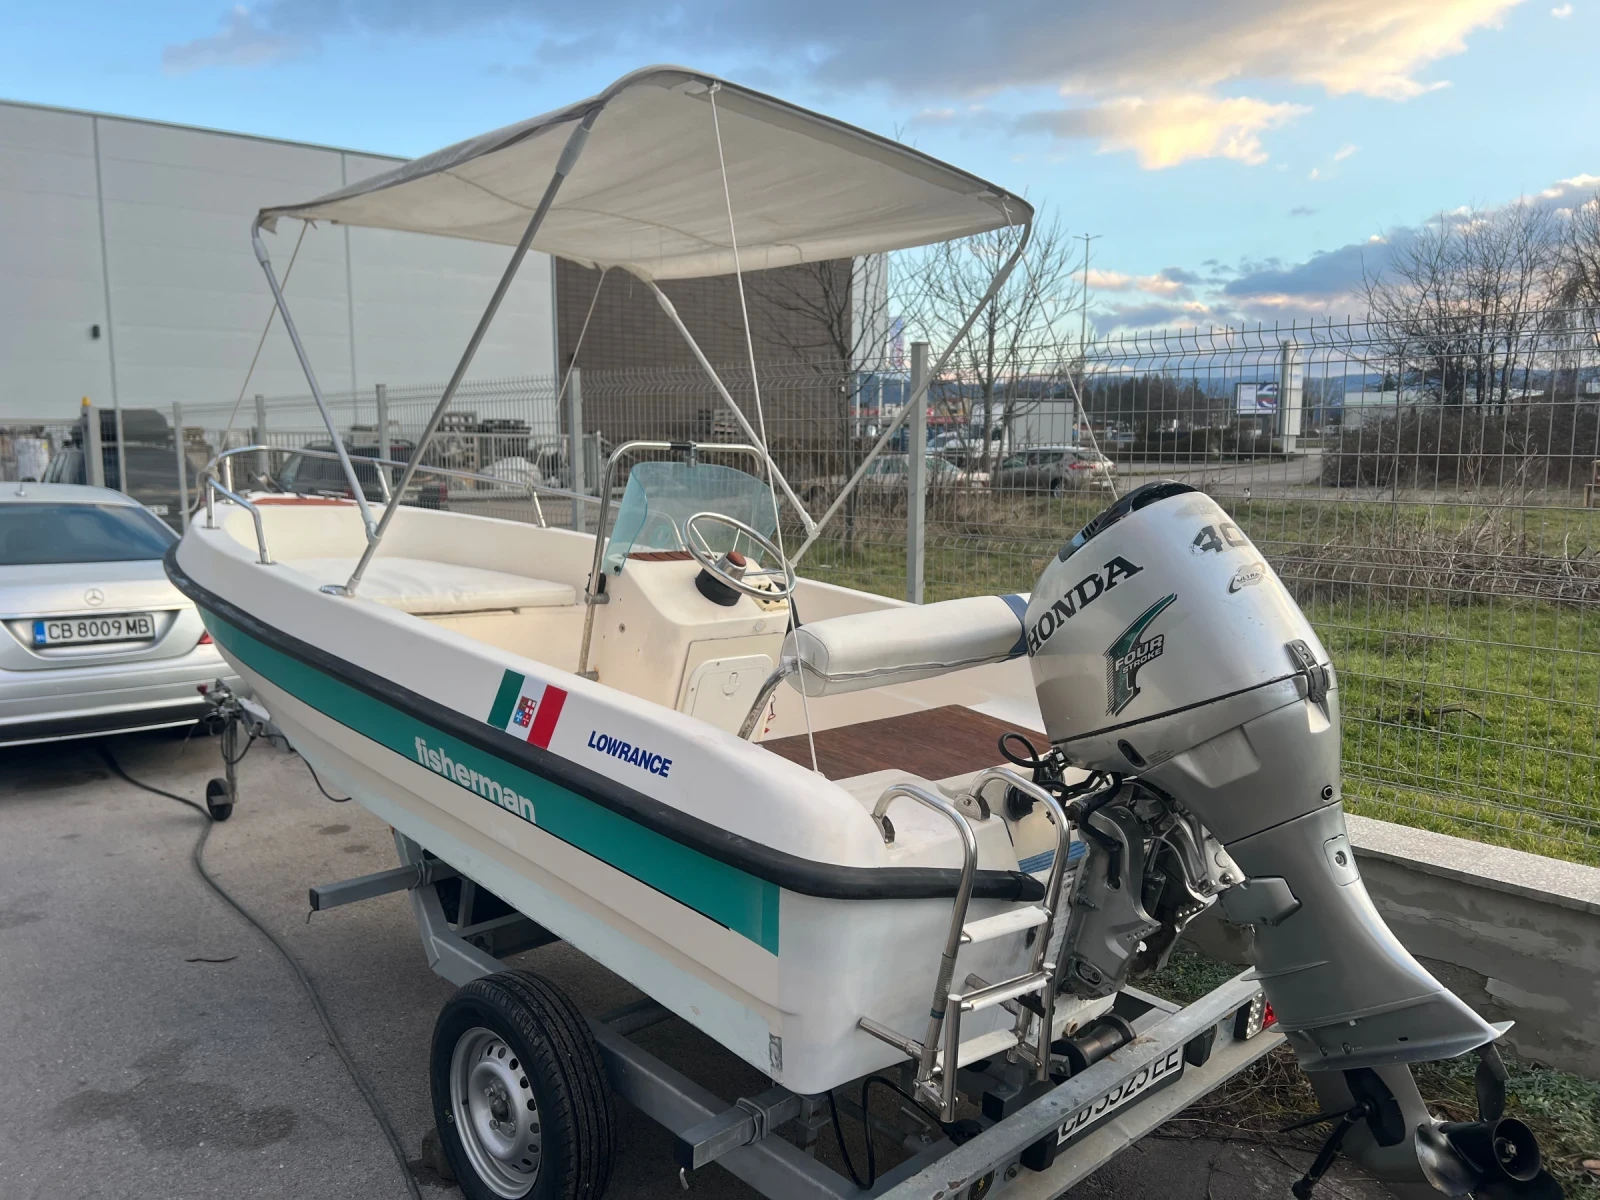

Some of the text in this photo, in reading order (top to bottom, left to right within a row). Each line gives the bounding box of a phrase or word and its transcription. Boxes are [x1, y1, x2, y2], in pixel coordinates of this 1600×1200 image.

[1027, 555, 1144, 658] HONDA
[48, 623, 73, 640] CB
[78, 620, 122, 638] 8009
[126, 618, 150, 634] MB
[1115, 635, 1163, 672] FOUR
[1122, 646, 1162, 674] STROKE
[587, 730, 673, 778] LOWRANCE
[414, 736, 537, 824] fisherman
